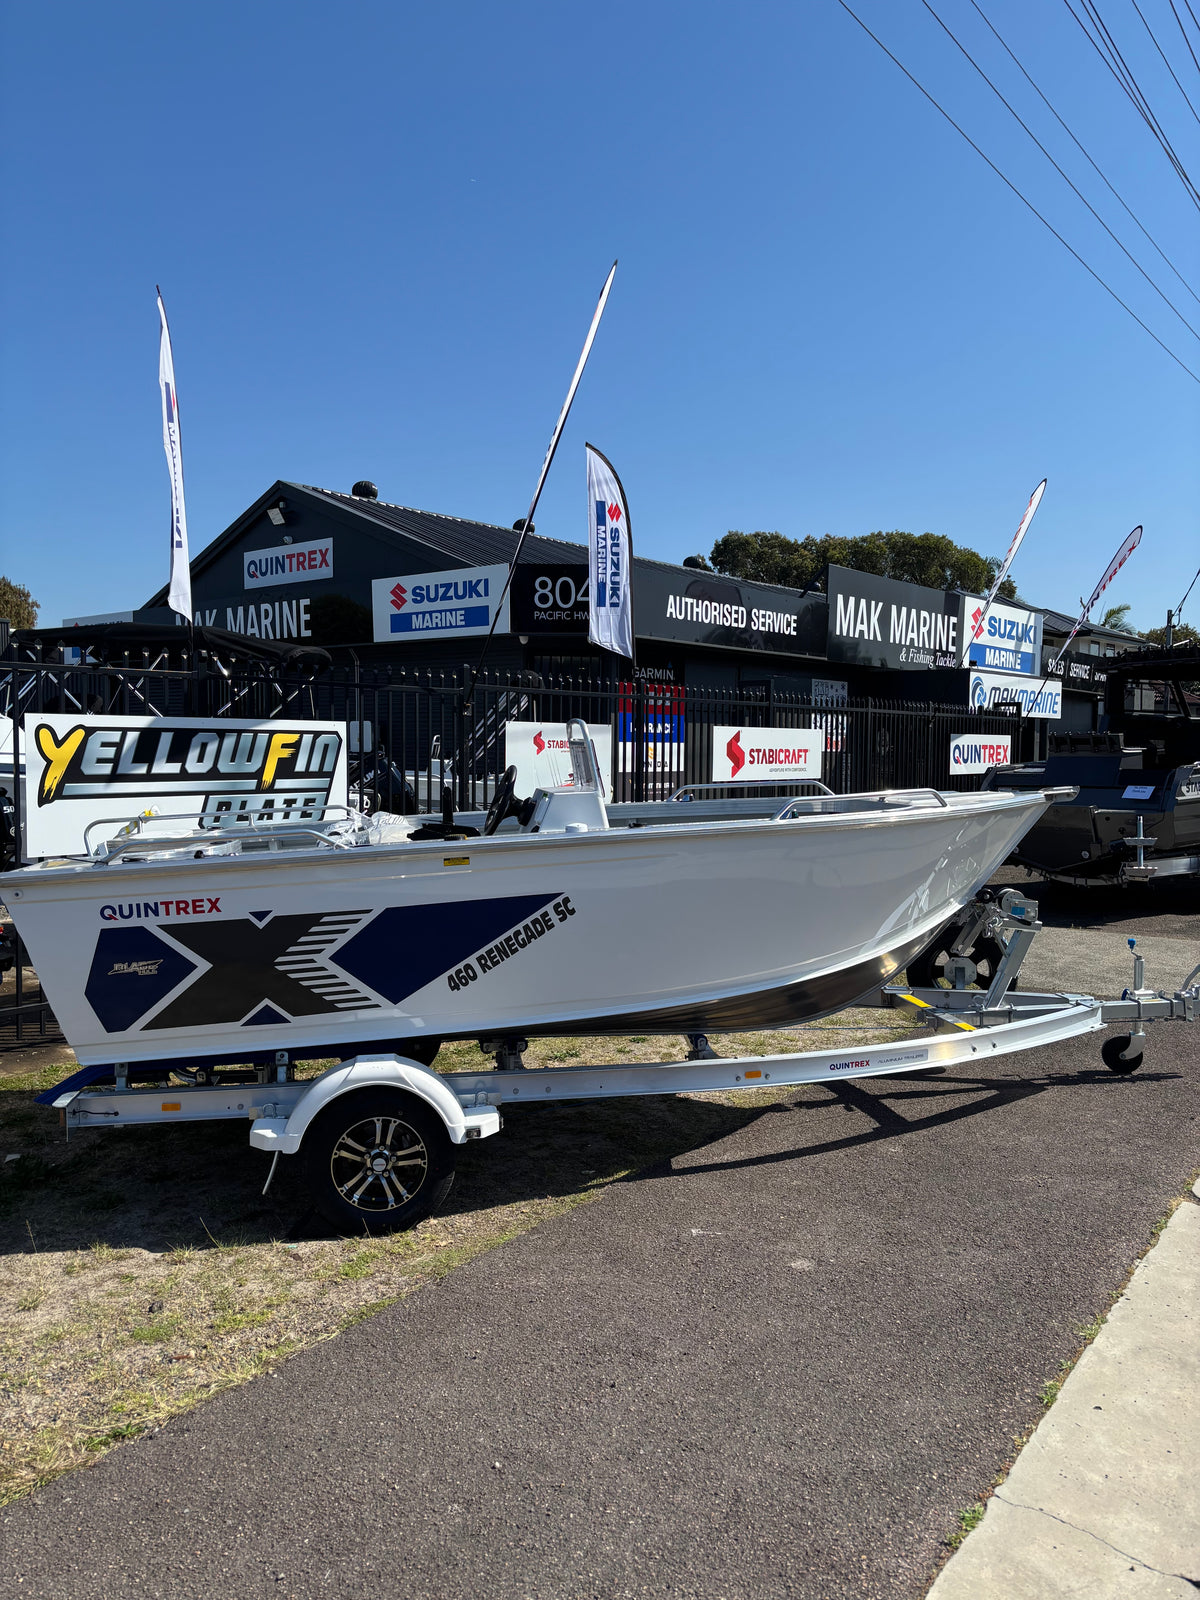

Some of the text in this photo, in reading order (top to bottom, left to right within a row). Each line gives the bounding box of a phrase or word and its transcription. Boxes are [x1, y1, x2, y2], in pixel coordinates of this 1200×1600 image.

[247, 548, 330, 579] QUINTREX
[597, 526, 606, 583] MARINE
[610, 527, 620, 608] SUZUKI
[411, 578, 490, 605] SUZUKI
[226, 598, 312, 640] MARINE
[411, 610, 466, 629] MARINE
[534, 611, 571, 621] PACIFIC
[666, 594, 798, 636] AUTHORISED SERVICE
[836, 593, 958, 653] MAK MARINE
[987, 615, 1037, 645] SUZUKI
[900, 647, 957, 668] & Fishing Tackle
[985, 647, 1022, 670] MARINE
[1069, 662, 1090, 679] SERVICE
[632, 666, 674, 681] GARMIN
[38, 726, 341, 802] YELLOWFIN
[748, 748, 809, 765] STABICRAFT
[952, 744, 1009, 766] QUINTREX
[213, 797, 317, 824] PLATE
[99, 897, 222, 921] QUINTREX
[447, 896, 576, 992] 460 RENEGADE SC
[829, 1060, 870, 1071] QUINTREX
